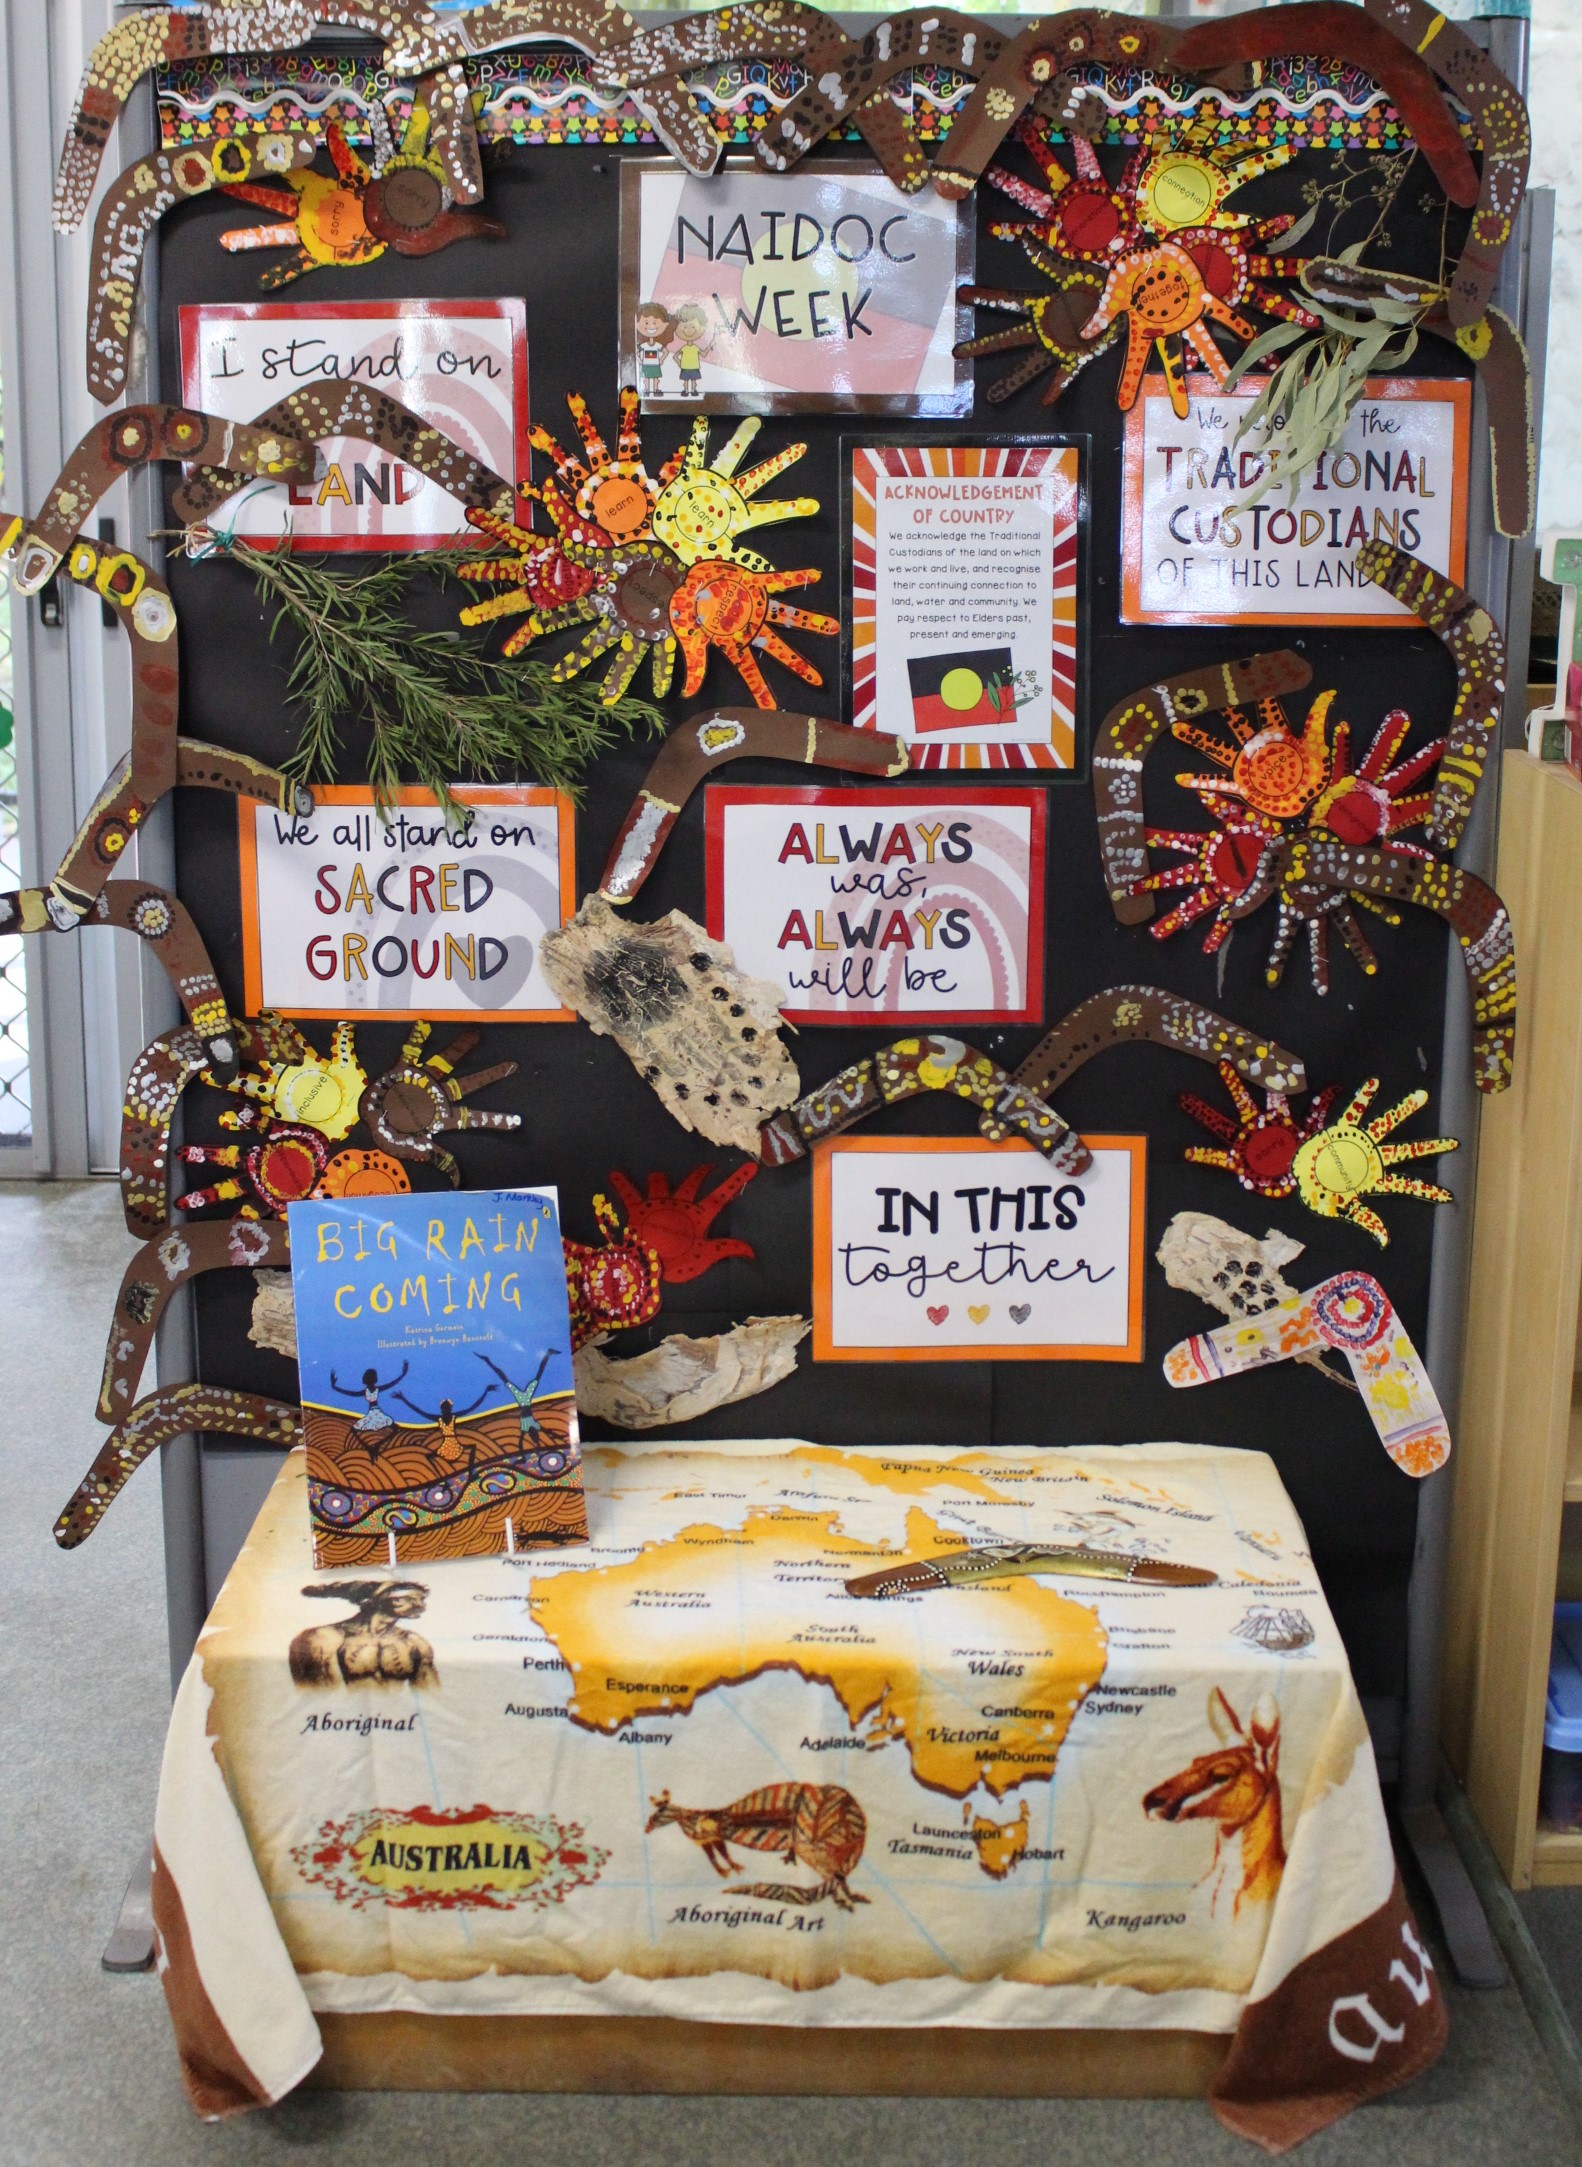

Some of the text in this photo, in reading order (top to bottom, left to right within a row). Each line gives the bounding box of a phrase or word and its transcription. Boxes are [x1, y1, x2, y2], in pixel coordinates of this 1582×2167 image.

[1161, 174, 1206, 207] connection
[330, 200, 345, 236] sorry
[677, 211, 916, 265] NAIDOC
[712, 285, 873, 339] WEEK
[210, 336, 501, 380] I stand on
[1197, 406, 1229, 430] We
[1360, 408, 1401, 437] the
[1157, 446, 1435, 497] TRADIIONAL
[288, 463, 426, 506] LAND
[885, 484, 1043, 500] ACKNOWLEDGEMENT
[605, 494, 635, 519] learn
[688, 500, 715, 528] learn
[913, 508, 1015, 524] OF COUNTRY
[889, 532, 1041, 542] We acknowledge the Traditional
[1168, 505, 1421, 550] CUSTODIANS
[889, 548, 1041, 557] Custodians of the land on which
[905, 565, 928, 573] work
[931, 565, 947, 573] and
[950, 565, 970, 575] live,
[972, 565, 990, 573] and
[991, 565, 1041, 574] recognise
[1157, 557, 1194, 587] OF
[1210, 558, 1280, 588] THIS
[893, 581, 916, 589] their
[919, 581, 968, 591] continuing
[971, 581, 1023, 590] connection
[710, 583, 737, 630] respect
[892, 597, 1037, 607] land, water and community. We
[897, 614, 1032, 624] pay respect to Elders past,
[910, 630, 1019, 640] present and emerging.
[1261, 755, 1288, 781] voice
[274, 810, 536, 853] We all stand on
[777, 822, 973, 864] ALWAYS
[315, 863, 493, 915] SACRED
[831, 867, 927, 900] was,
[777, 909, 971, 951] ALWAYS
[305, 932, 509, 981] GROUND
[789, 956, 958, 999] will be
[297, 1075, 328, 1116] inclusive
[875, 1184, 1086, 1236] IN THIS
[317, 1213, 538, 1263] BIG RAIN
[838, 1241, 1116, 1298] together
[334, 1271, 522, 1319] COMING
[405, 1326, 432, 1335] Katrina
[377, 1339, 416, 1348] Illustrated
[418, 1338, 427, 1348] by
[674, 1491, 748, 1499] East Timor
[683, 1537, 755, 1546] Wyndham
[933, 1535, 1004, 1545] Cooktown
[773, 1559, 850, 1569] Northern
[624, 1599, 712, 1609] Australia
[634, 1588, 707, 1598] Western
[523, 1656, 565, 1671] Perth
[968, 1659, 1025, 1677] Wales
[606, 1678, 690, 1695] Esperance
[1096, 1683, 1178, 1698] Newcastle
[504, 1703, 569, 1719] Augusta
[981, 1705, 1056, 1720] Canberra
[1084, 1701, 1144, 1716] Sydney
[300, 1713, 419, 1737] Aboriginal
[927, 1726, 1000, 1744] Victoria
[618, 1731, 673, 1746] Albany
[800, 1736, 867, 1752] Adelaide
[974, 1749, 1057, 1764] Melbourne
[913, 1822, 1002, 1841] Launceston
[370, 1838, 533, 1873] AUSTRALIA
[887, 1839, 974, 1861] Tasmania
[1012, 1848, 1066, 1861] Hobart
[667, 1905, 826, 1932] Aboriginal Art
[1086, 1907, 1188, 1932] Kangaroo
